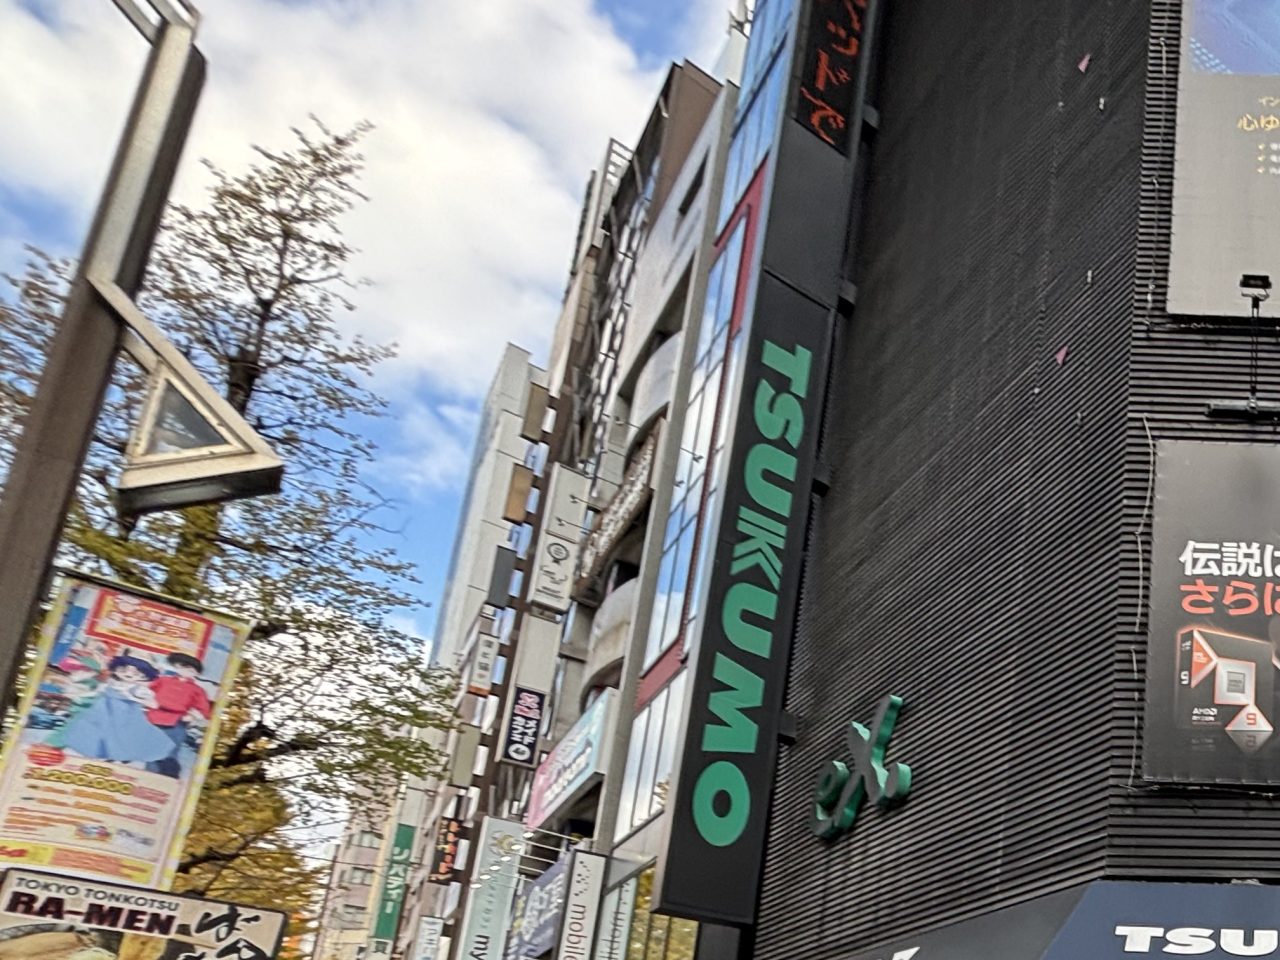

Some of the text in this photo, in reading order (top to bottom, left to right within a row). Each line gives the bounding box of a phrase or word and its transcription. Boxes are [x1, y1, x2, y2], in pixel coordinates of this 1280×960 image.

[692, 337, 811, 848] TSUKUMO
[5, 891, 177, 936] RA-MEN
[16, 877, 180, 912] TOKYO TONKOTSU
[469, 934, 490, 960] my
